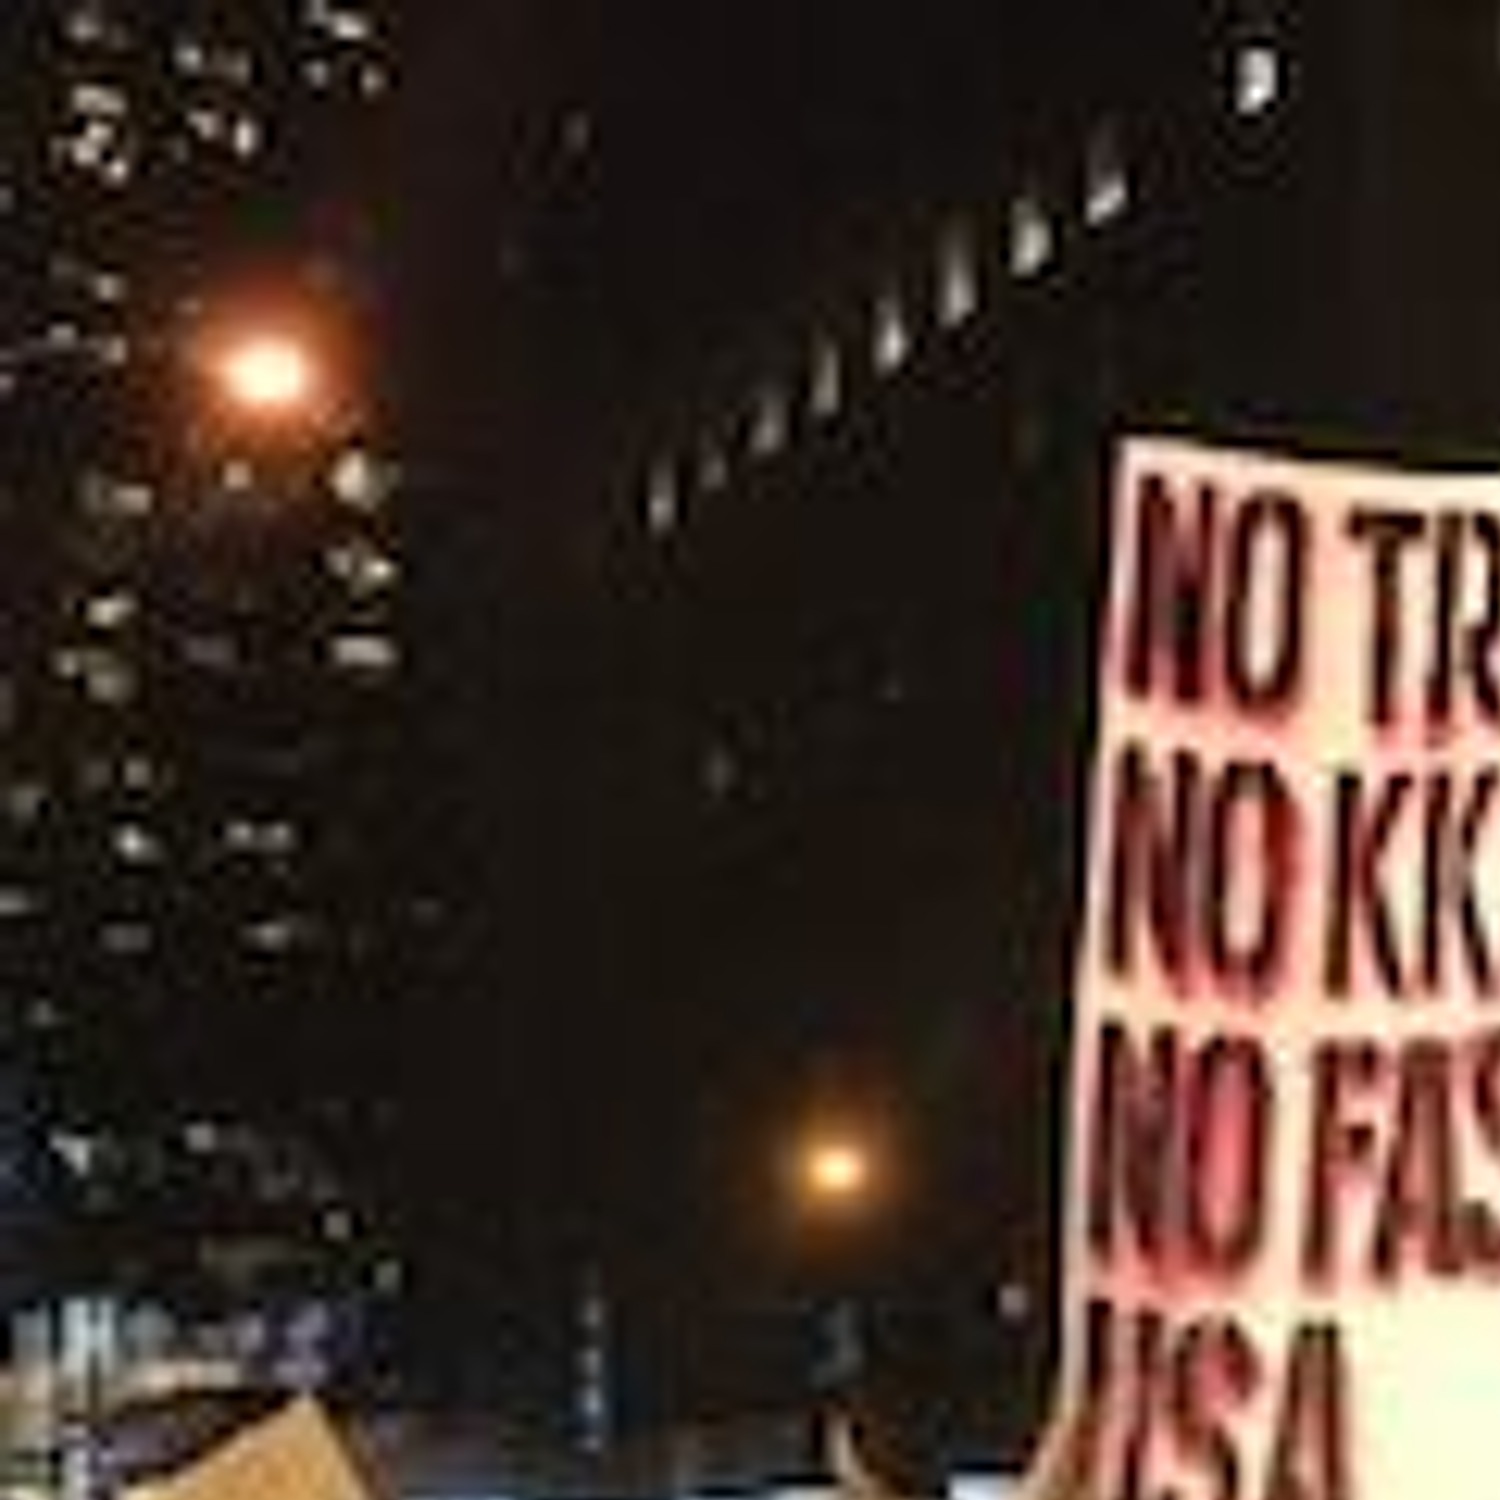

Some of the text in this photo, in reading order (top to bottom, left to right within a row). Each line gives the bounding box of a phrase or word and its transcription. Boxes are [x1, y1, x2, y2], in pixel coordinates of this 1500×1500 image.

[1124, 472, 1310, 726] NO
[1104, 740, 1302, 990] NO
[1088, 1022, 1274, 1276] NO
